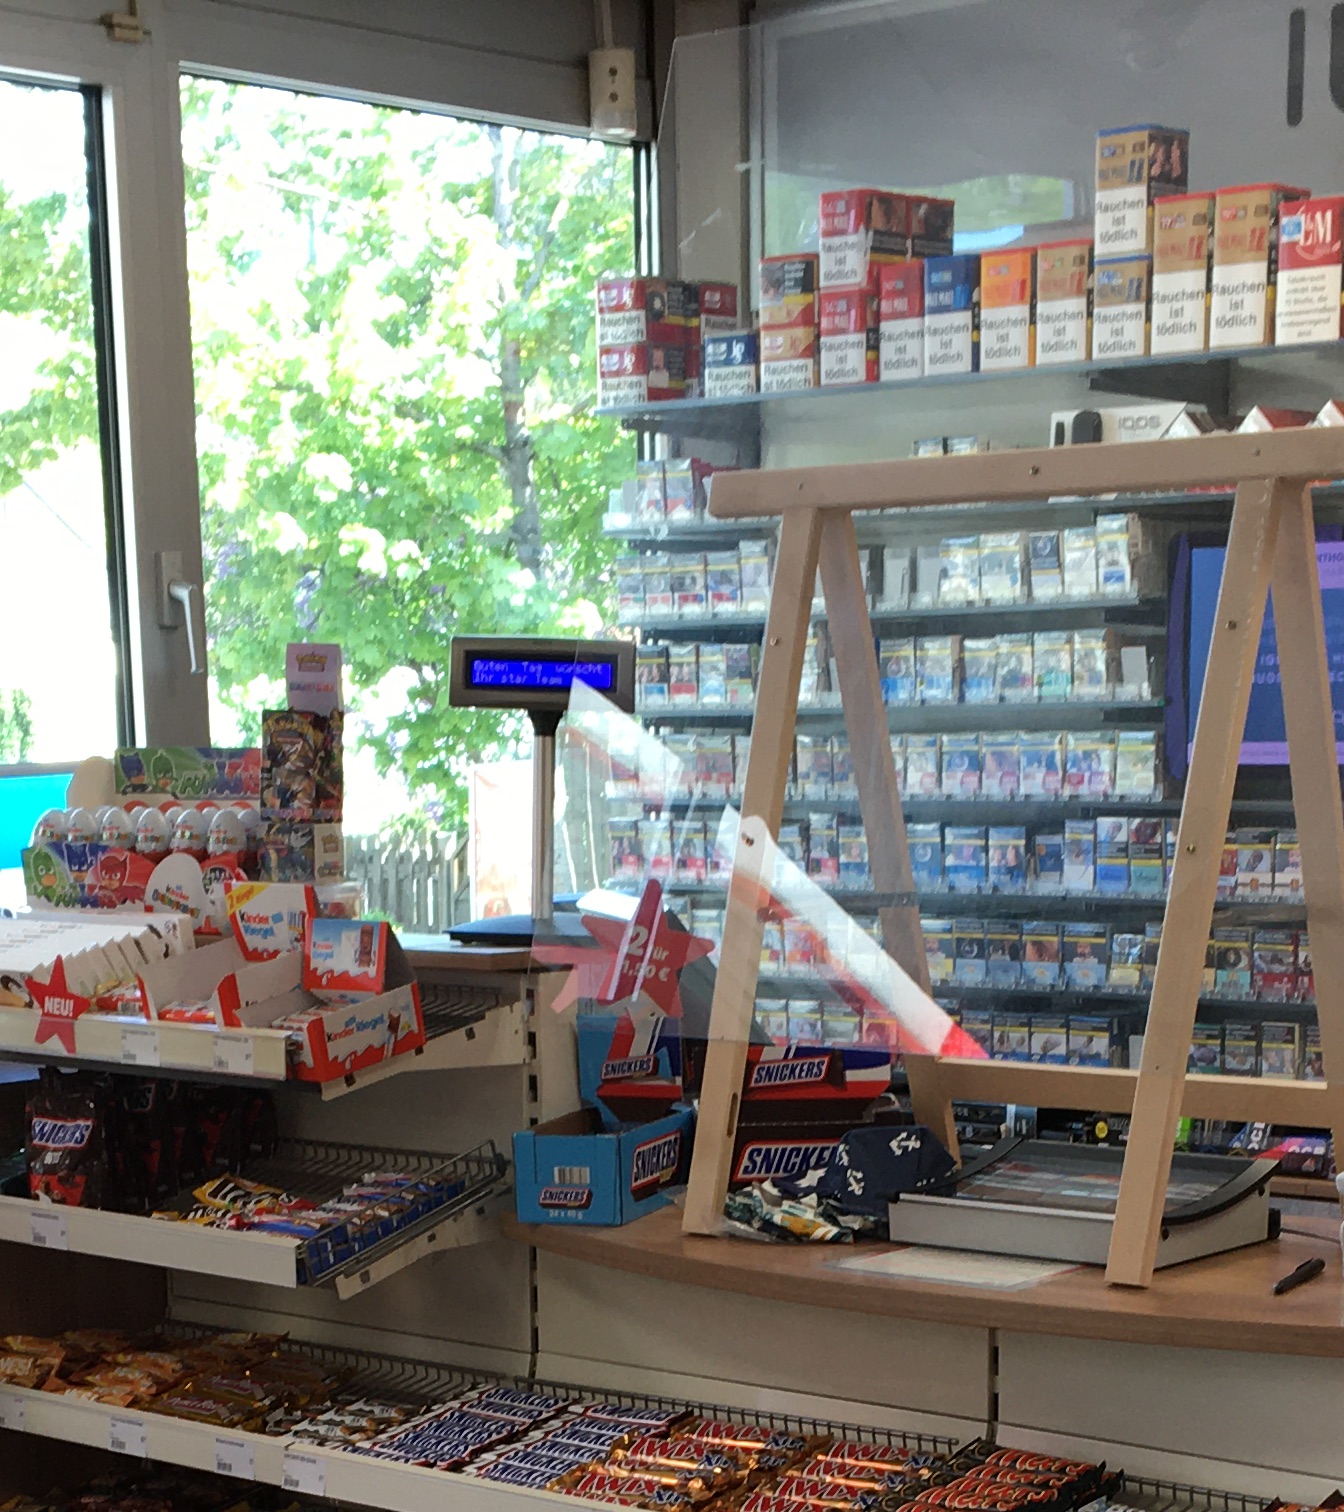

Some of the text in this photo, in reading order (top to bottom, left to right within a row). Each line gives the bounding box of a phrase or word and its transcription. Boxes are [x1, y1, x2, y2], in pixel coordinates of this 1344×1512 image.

[44, 996, 74, 1017] NEU!
[603, 1057, 652, 1075] SNICKERS
[755, 1060, 827, 1084] SNICKERS
[632, 1136, 679, 1182] SNICKERS
[542, 1189, 587, 1203] SNICKERS
